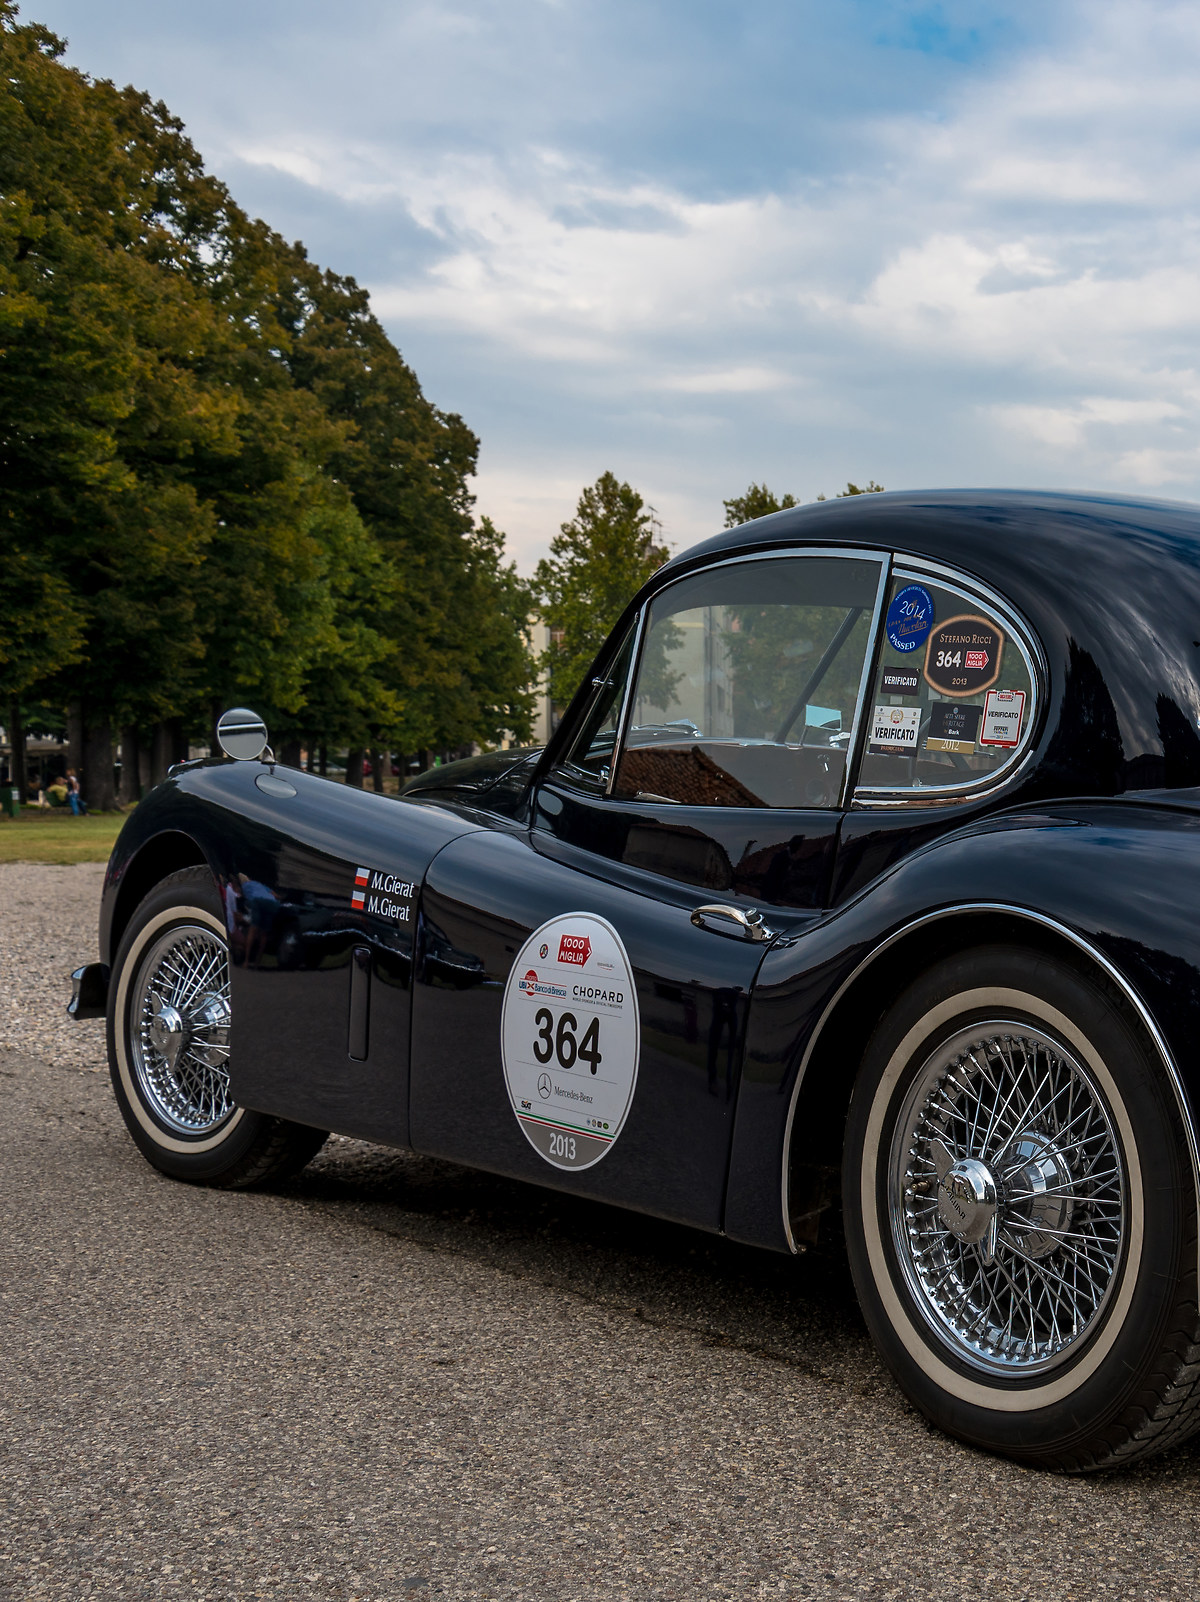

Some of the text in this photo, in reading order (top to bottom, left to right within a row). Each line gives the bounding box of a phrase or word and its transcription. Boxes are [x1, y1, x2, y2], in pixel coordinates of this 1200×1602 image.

[900, 600, 926, 620] 2014
[890, 633, 916, 650] PASSED
[940, 634, 992, 645] STEFANO RICCI
[936, 650, 962, 668] 364
[884, 676, 918, 687] VERIFICATO
[988, 711, 1019, 719] VERIFICATO
[875, 726, 915, 741] VERIFICATO
[941, 740, 960, 751] 2012
[371, 872, 414, 898] M.Gierat
[368, 895, 410, 922] M.Gierat
[563, 938, 585, 950] 1000
[558, 950, 584, 963] MIGLIA
[518, 981, 527, 989] UBI
[572, 985, 624, 1003] CHOPARD
[532, 1007, 602, 1076] 364
[554, 1086, 594, 1104] Mercedes-Benz
[549, 1132, 576, 1160] 2013
